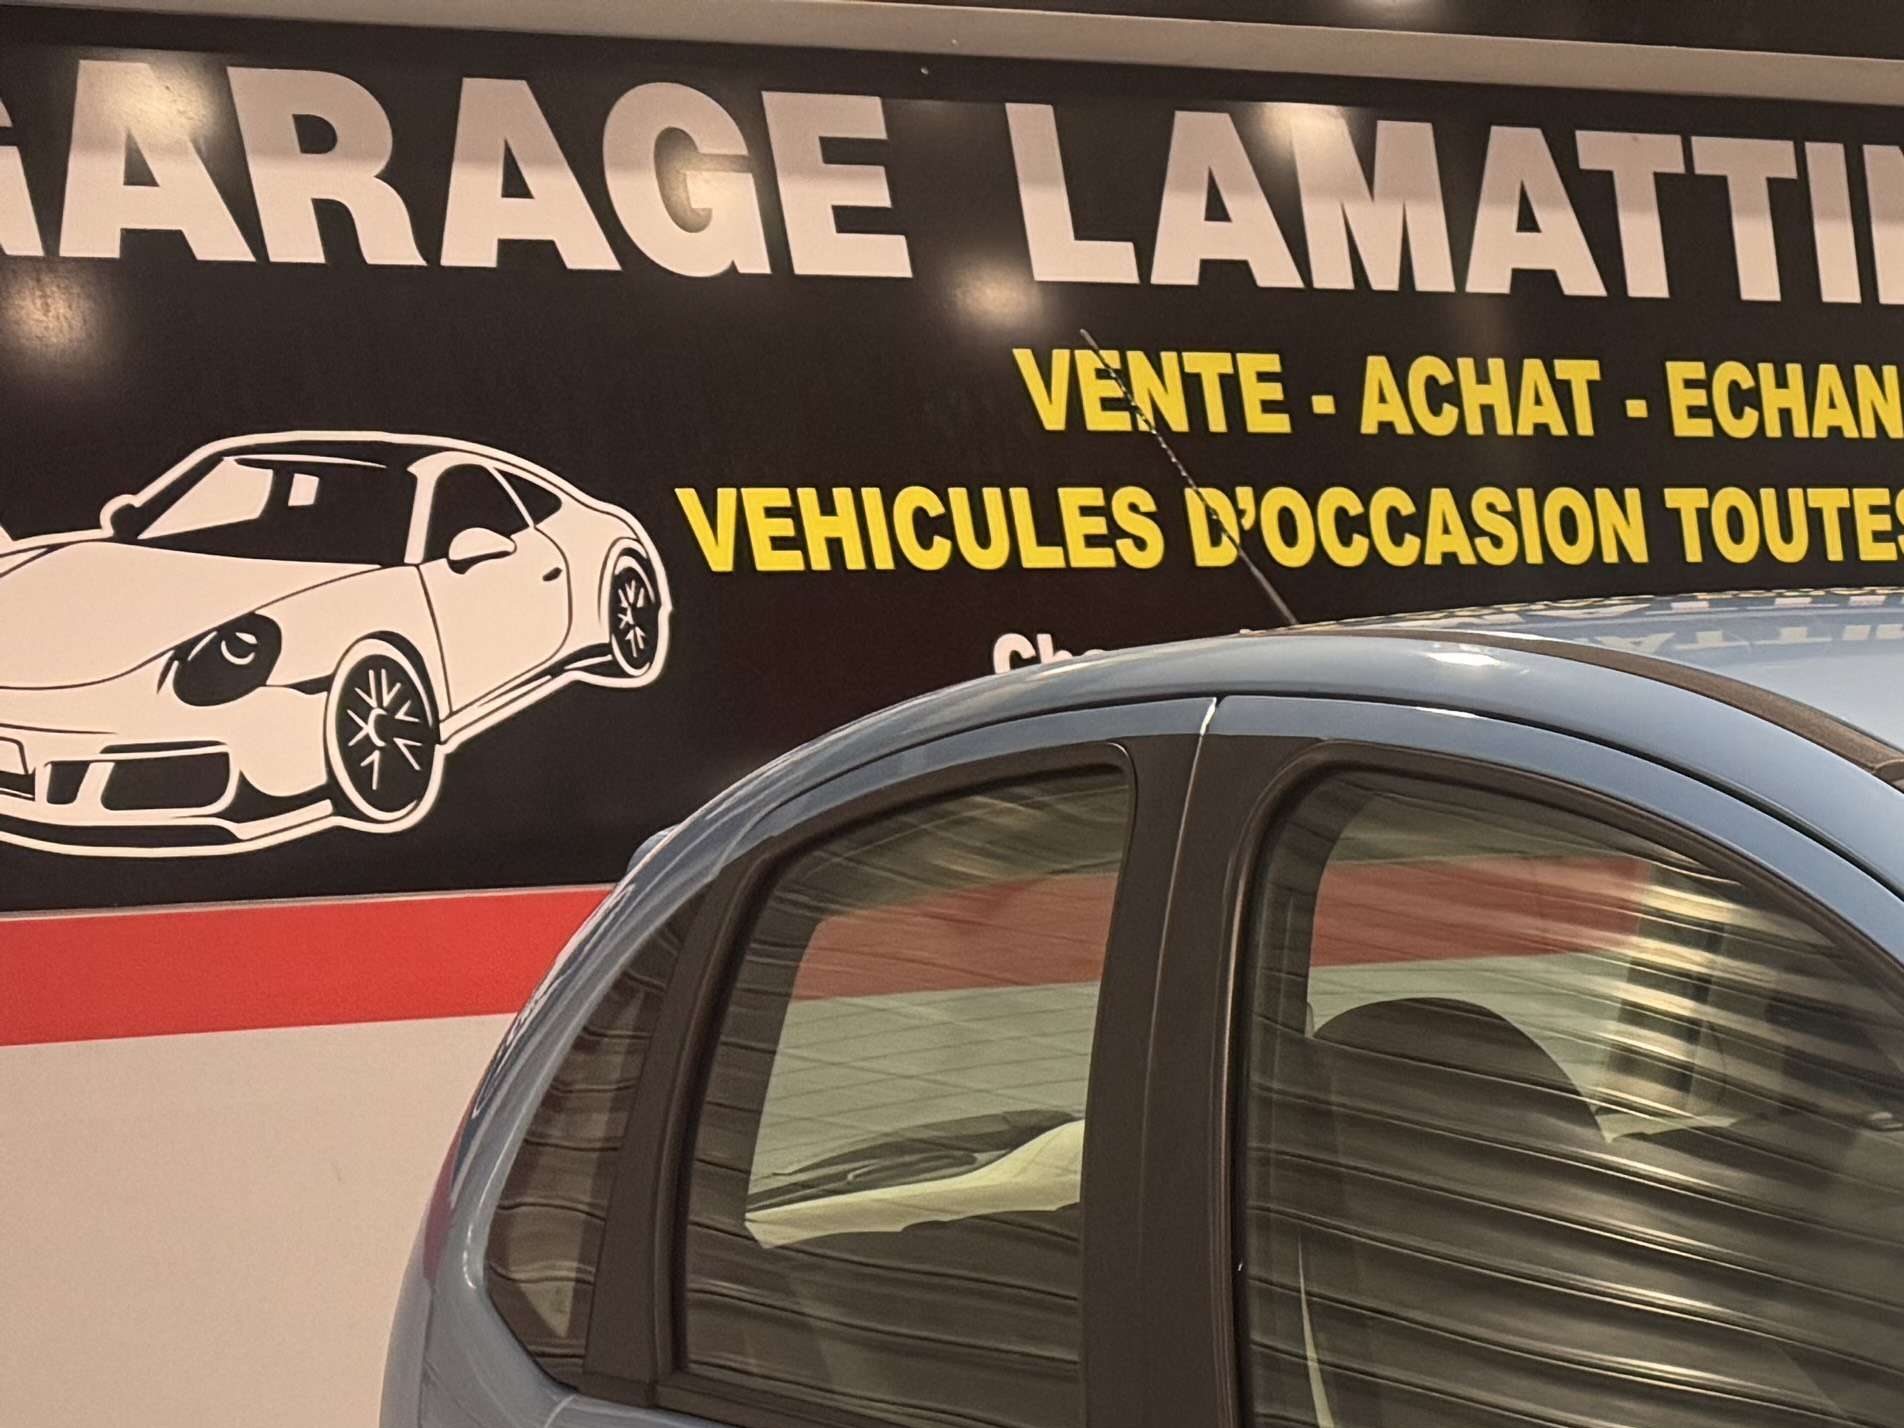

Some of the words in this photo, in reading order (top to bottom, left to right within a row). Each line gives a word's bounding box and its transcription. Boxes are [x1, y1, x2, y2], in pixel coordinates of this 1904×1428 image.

[0, 58, 914, 281] ARAGE
[1013, 347, 1293, 435] VENTE
[1311, 394, 1336, 415] -
[1360, 354, 1603, 438] ACHAT
[1625, 399, 1649, 418] -
[675, 486, 1167, 574] VEHICULES
[1183, 486, 1651, 568] D'OCCASION
